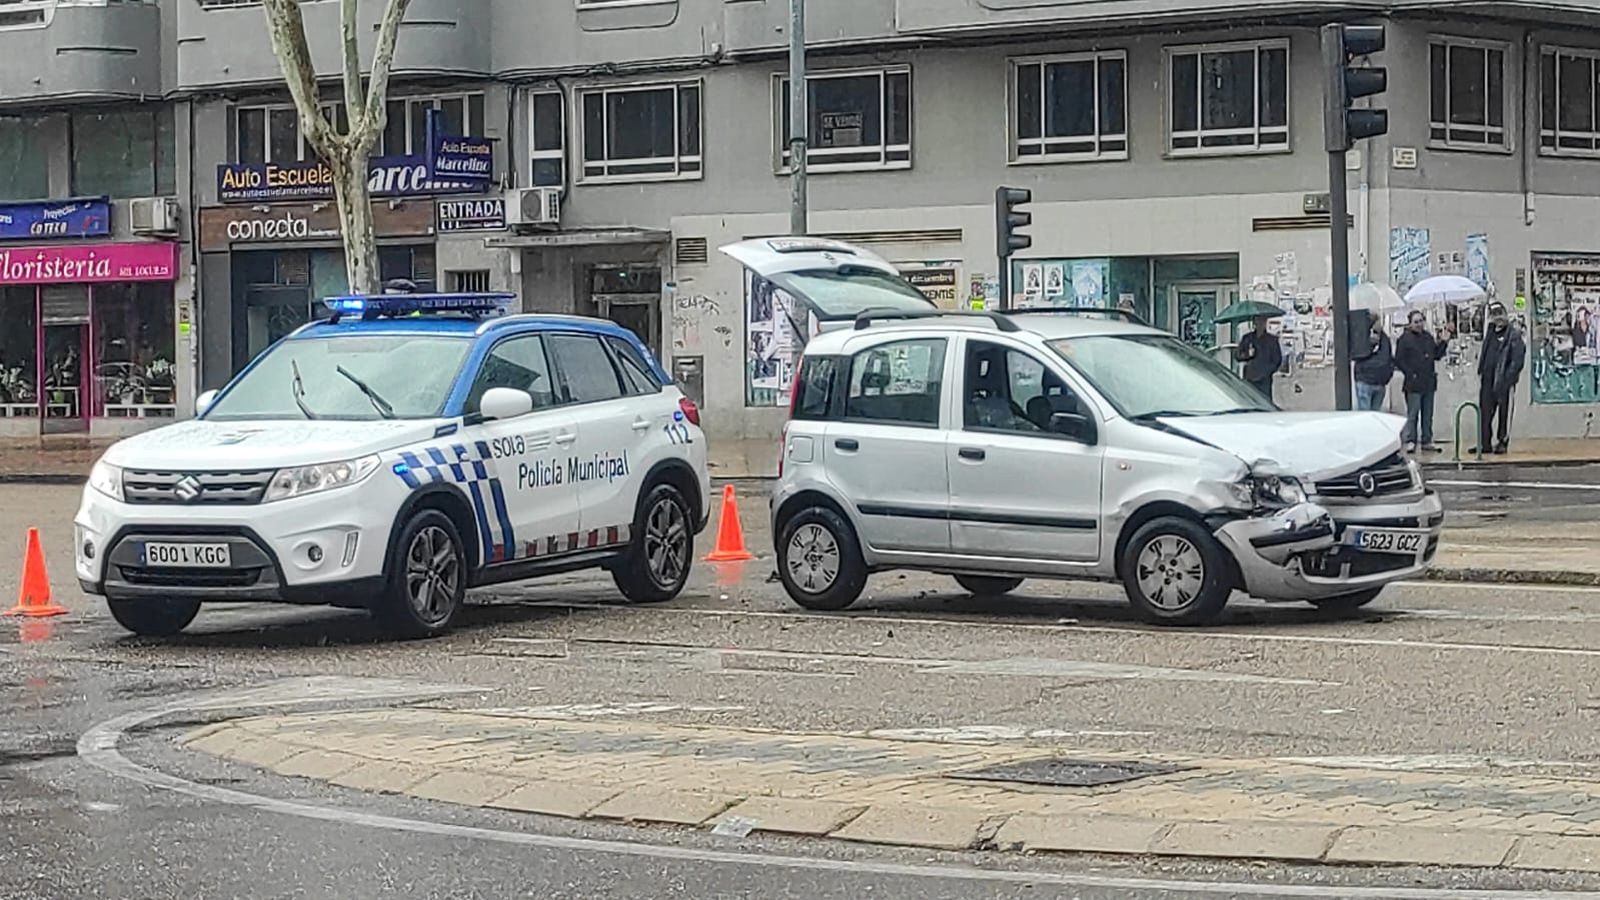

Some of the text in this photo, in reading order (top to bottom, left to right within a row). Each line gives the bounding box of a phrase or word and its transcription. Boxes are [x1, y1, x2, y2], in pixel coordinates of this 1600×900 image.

[222, 163, 333, 188] Auto Escuela
[440, 201, 503, 218] ENTRADA
[227, 212, 307, 239] conecta
[0, 250, 111, 280] loristeria
[663, 423, 693, 445] 112
[519, 449, 630, 490] Policía Municipal
[1361, 533, 1421, 552] 5623 GCZ
[149, 545, 226, 564] 6001 KGC
